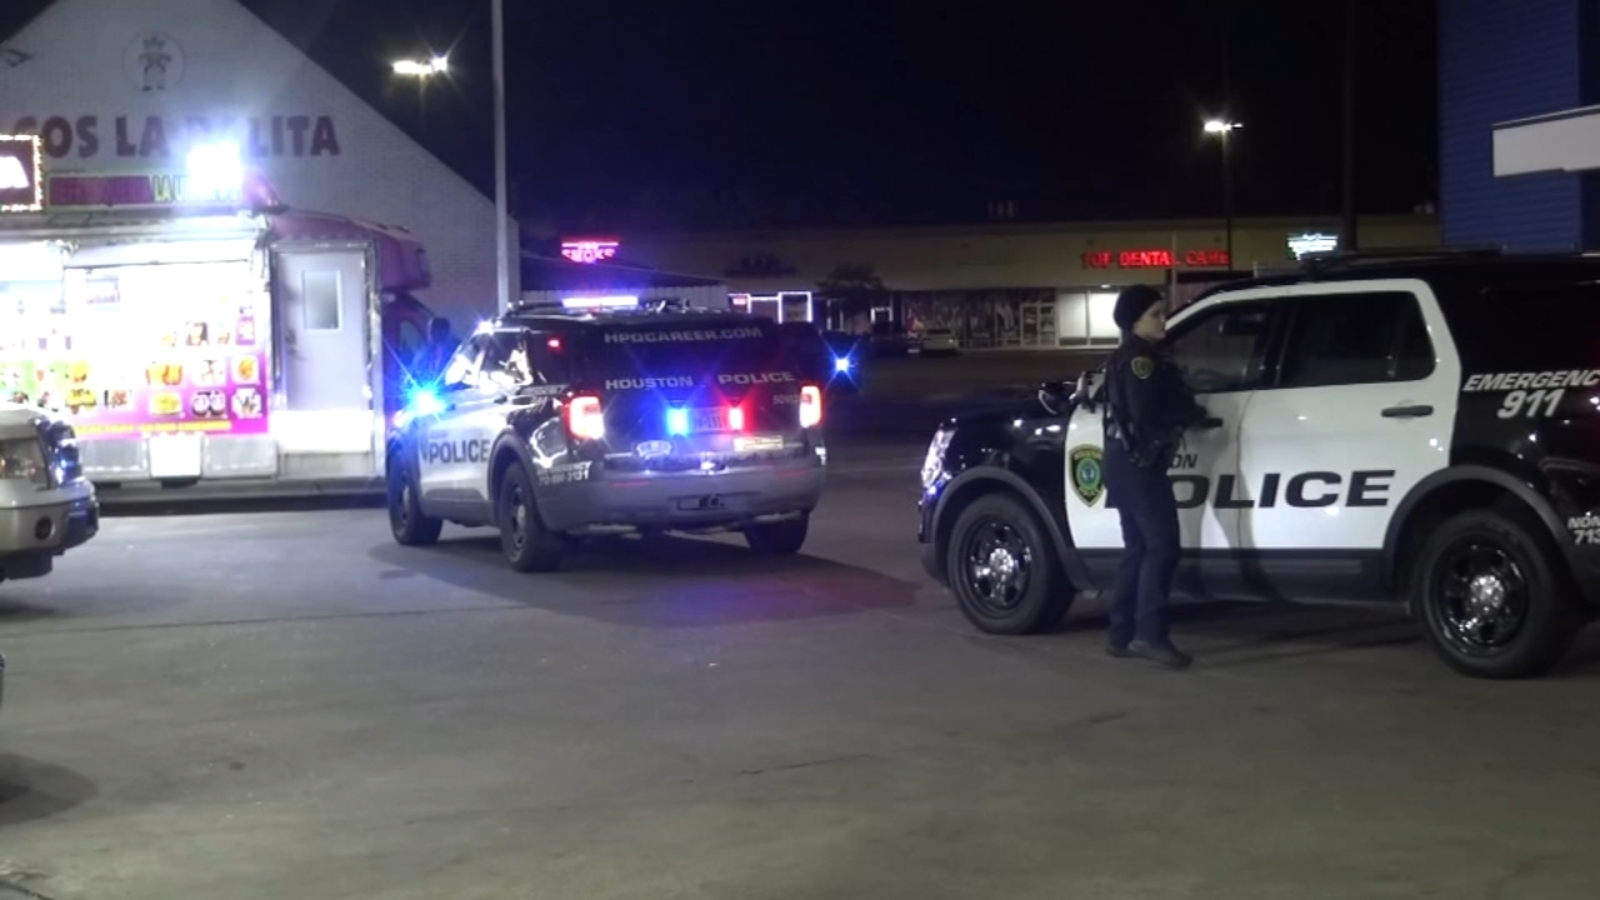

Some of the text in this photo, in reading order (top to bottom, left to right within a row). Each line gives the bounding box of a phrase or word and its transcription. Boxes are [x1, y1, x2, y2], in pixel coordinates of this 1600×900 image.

[116, 115, 170, 157] LA
[187, 115, 342, 157] LITA
[605, 372, 795, 390] HOUSTON POLICE
[1497, 388, 1566, 418] 911
[429, 439, 491, 465] POLICE
[1104, 470, 1396, 510] OLICE
